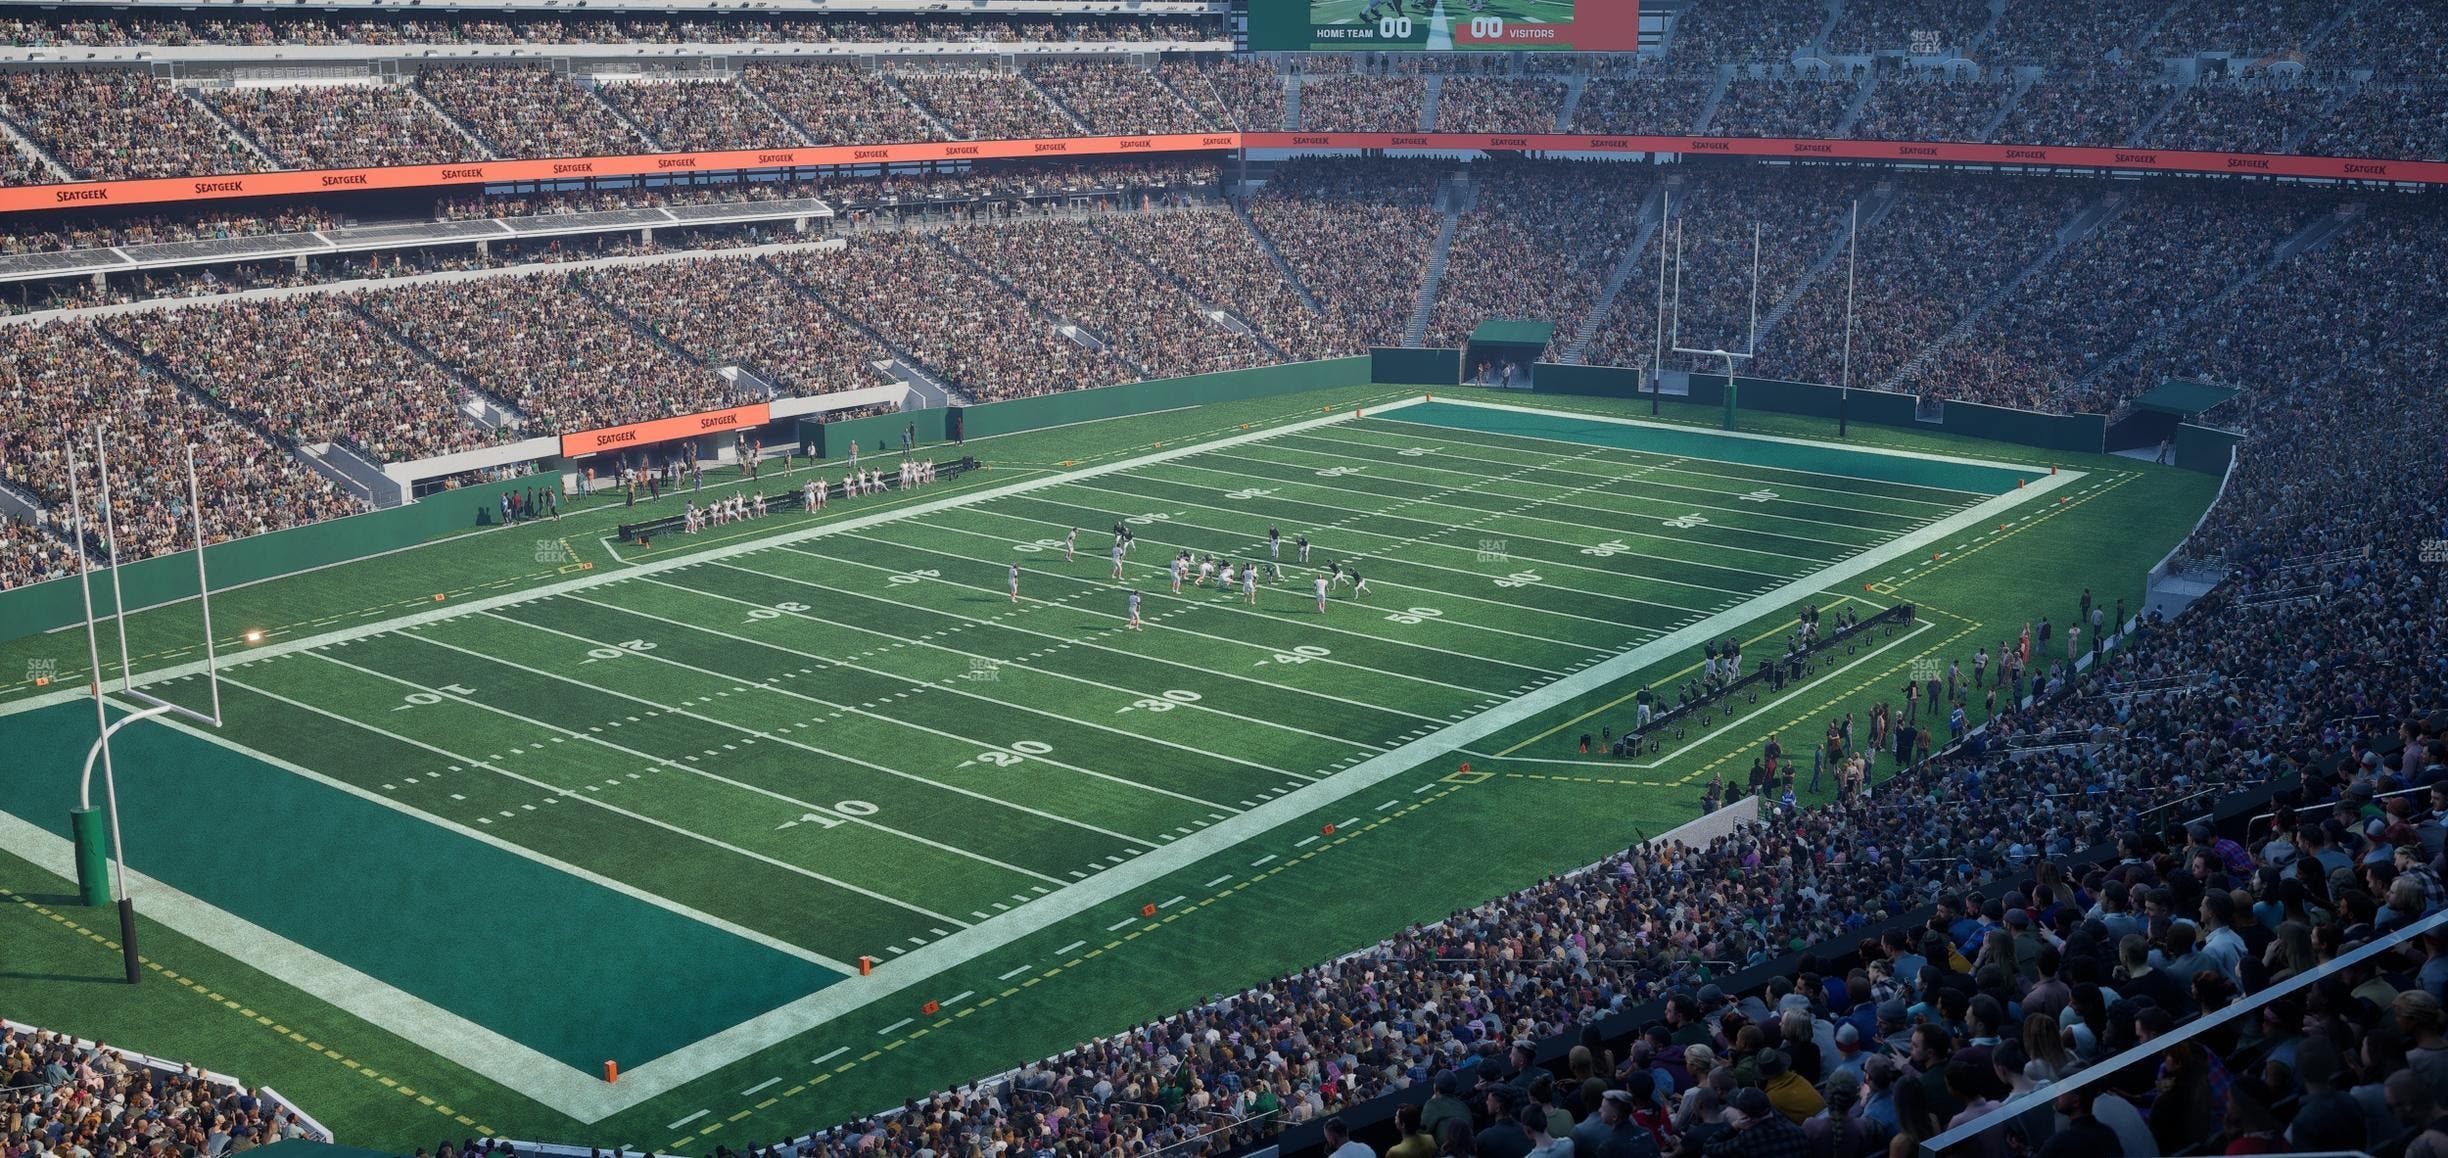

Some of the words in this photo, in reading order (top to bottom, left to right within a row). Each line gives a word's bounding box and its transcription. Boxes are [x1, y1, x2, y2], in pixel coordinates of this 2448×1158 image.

[1317, 29, 1345, 38] HOME
[1347, 29, 1373, 38] TEAM
[1379, 16, 1412, 39] 00
[1471, 16, 1503, 39] 00
[1509, 29, 1555, 38] VISITORS
[1119, 139, 1152, 149] SEATGEEK
[1202, 137, 1232, 146] SEATGEEK
[1292, 136, 1329, 145] SEATGEEK
[1391, 137, 1428, 146] SEATGEEK
[1490, 137, 1527, 147] SEATGEEK
[1590, 139, 1629, 149] SEATGEEK
[1691, 140, 1730, 151] SEATGEEK
[945, 146, 979, 156] SEATGEEK
[1034, 142, 1067, 153] SEATGEEK
[1793, 143, 1832, 153] SEATGEEK
[1899, 145, 1938, 156] SEATGEEK
[758, 153, 794, 165] SEATGEEK
[853, 149, 889, 160] SEATGEEK
[2005, 149, 2047, 160] SEATGEEK
[2114, 153, 2157, 164] SEATGEEK
[553, 162, 593, 174] SEATGEEK
[658, 157, 696, 169] SEATGEEK
[2226, 158, 2269, 170] SEATGEEK
[2343, 163, 2386, 175] SEATGEEK
[441, 167, 484, 180] SEATGEEK
[321, 174, 368, 187] SEATGEEK
[194, 180, 244, 194] SEATGEEK
[56, 188, 108, 203] SEATGEEK
[701, 414, 737, 429] SEATGEEK
[597, 431, 636, 446] SEATGEEK
[1581, 542, 1630, 556] 30
[1493, 573, 1542, 587] 40
[1384, 607, 1443, 624] 50
[588, 639, 657, 659] 20
[1273, 646, 1330, 663] 40
[1133, 690, 1202, 711] 30
[977, 741, 1053, 767] 20
[800, 799, 879, 829] 10
